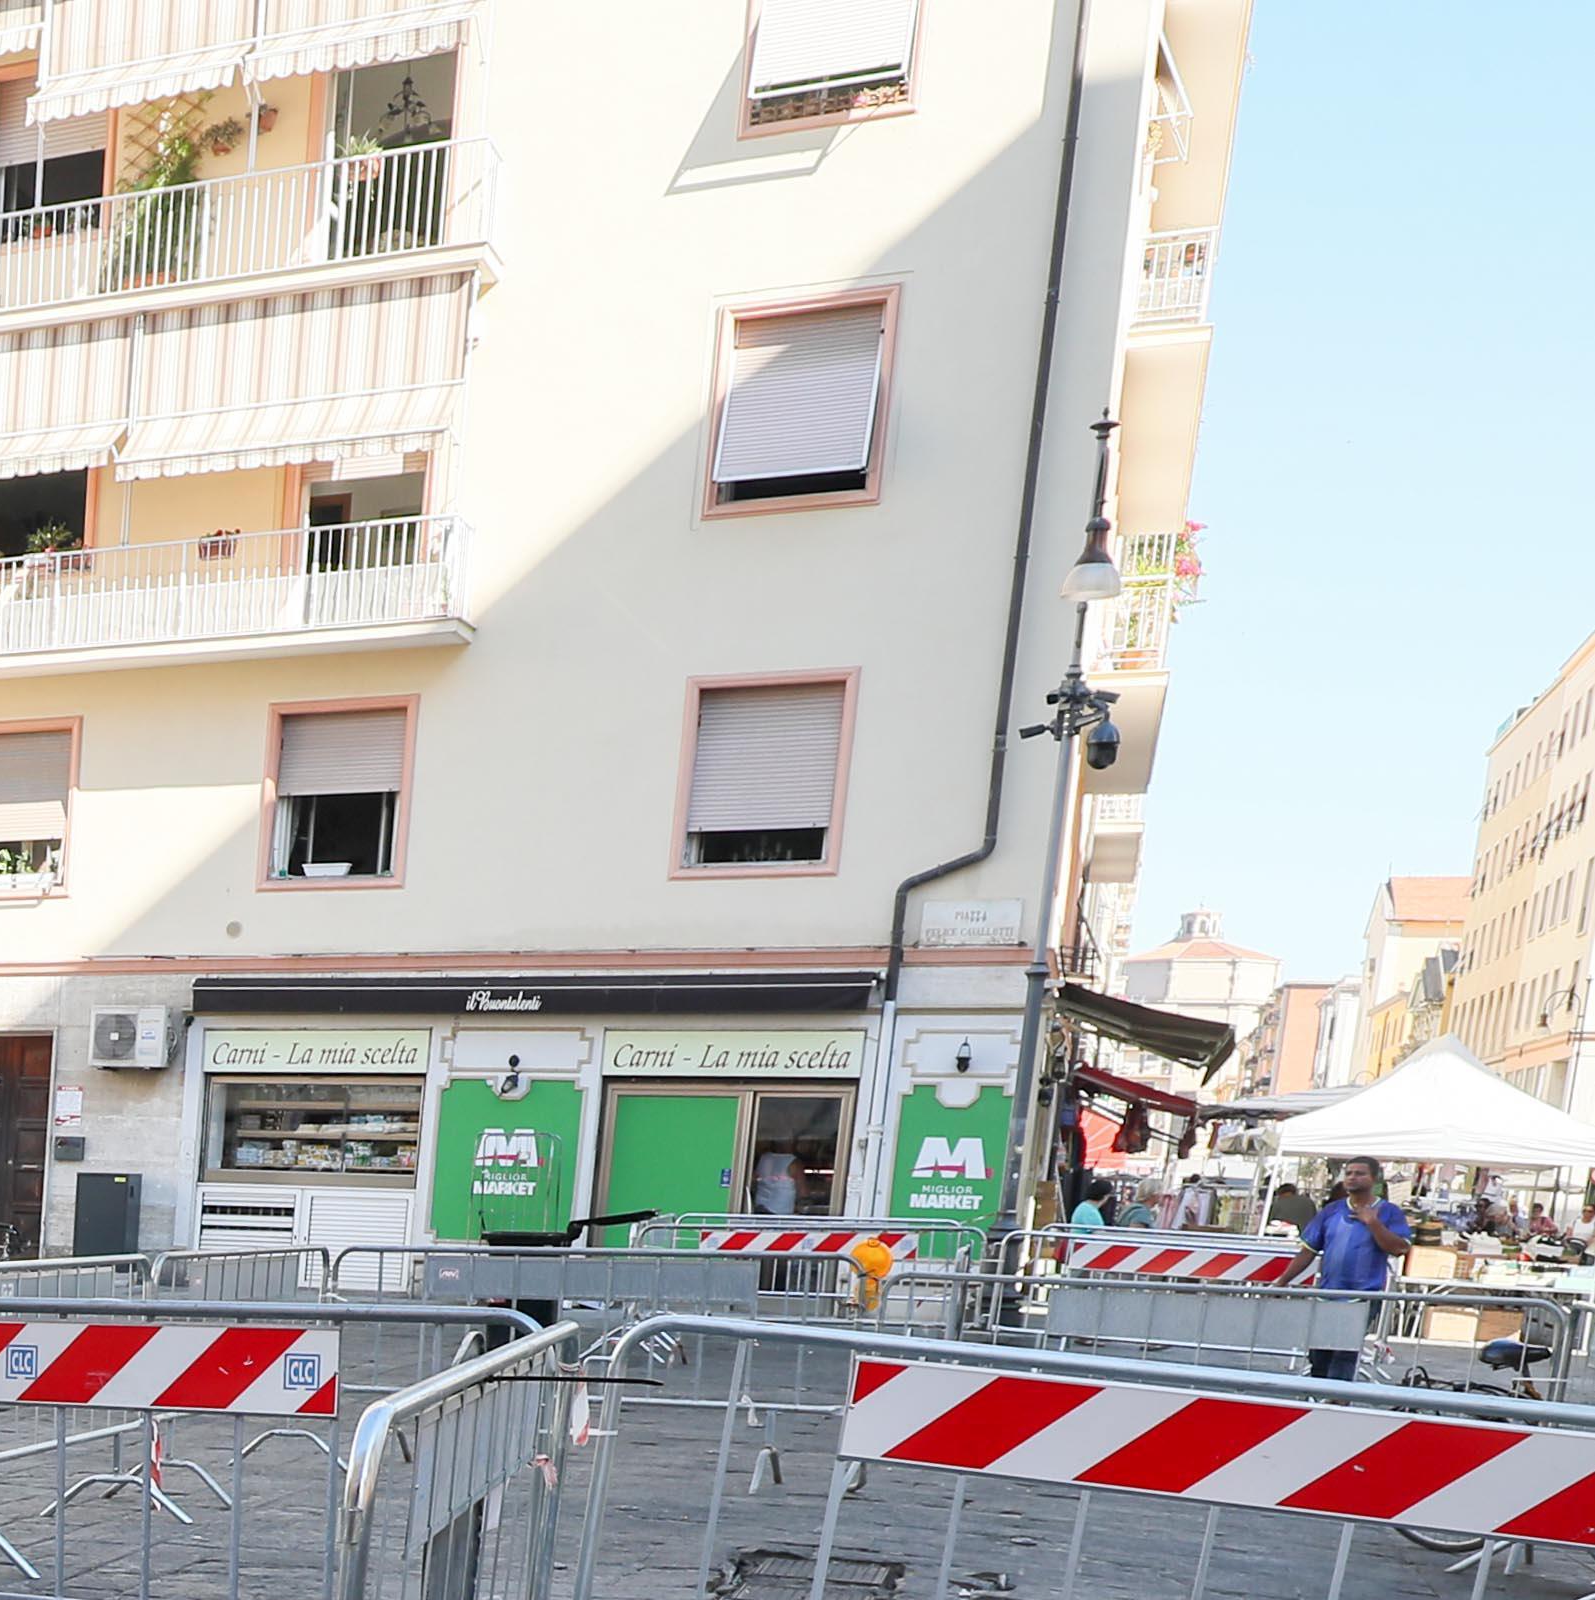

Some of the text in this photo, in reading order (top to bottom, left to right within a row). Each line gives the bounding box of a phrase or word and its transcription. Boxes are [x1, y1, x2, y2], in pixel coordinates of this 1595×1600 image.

[954, 910, 987, 922] PIAZZA
[212, 1041, 268, 1066] Carni
[286, 1041, 311, 1066] La
[320, 1042, 356, 1066] mia
[363, 1037, 419, 1065] scelta
[613, 1042, 678, 1069] Carni
[698, 1043, 730, 1069] La
[735, 1043, 780, 1069] mia
[783, 1039, 852, 1069] scelta
[472, 1180, 538, 1196] MARKET
[921, 1184, 974, 1195] MIGLIOR
[909, 1193, 984, 1211] MARKET
[10, 1349, 34, 1375] CLC
[289, 1359, 315, 1385] CLC
